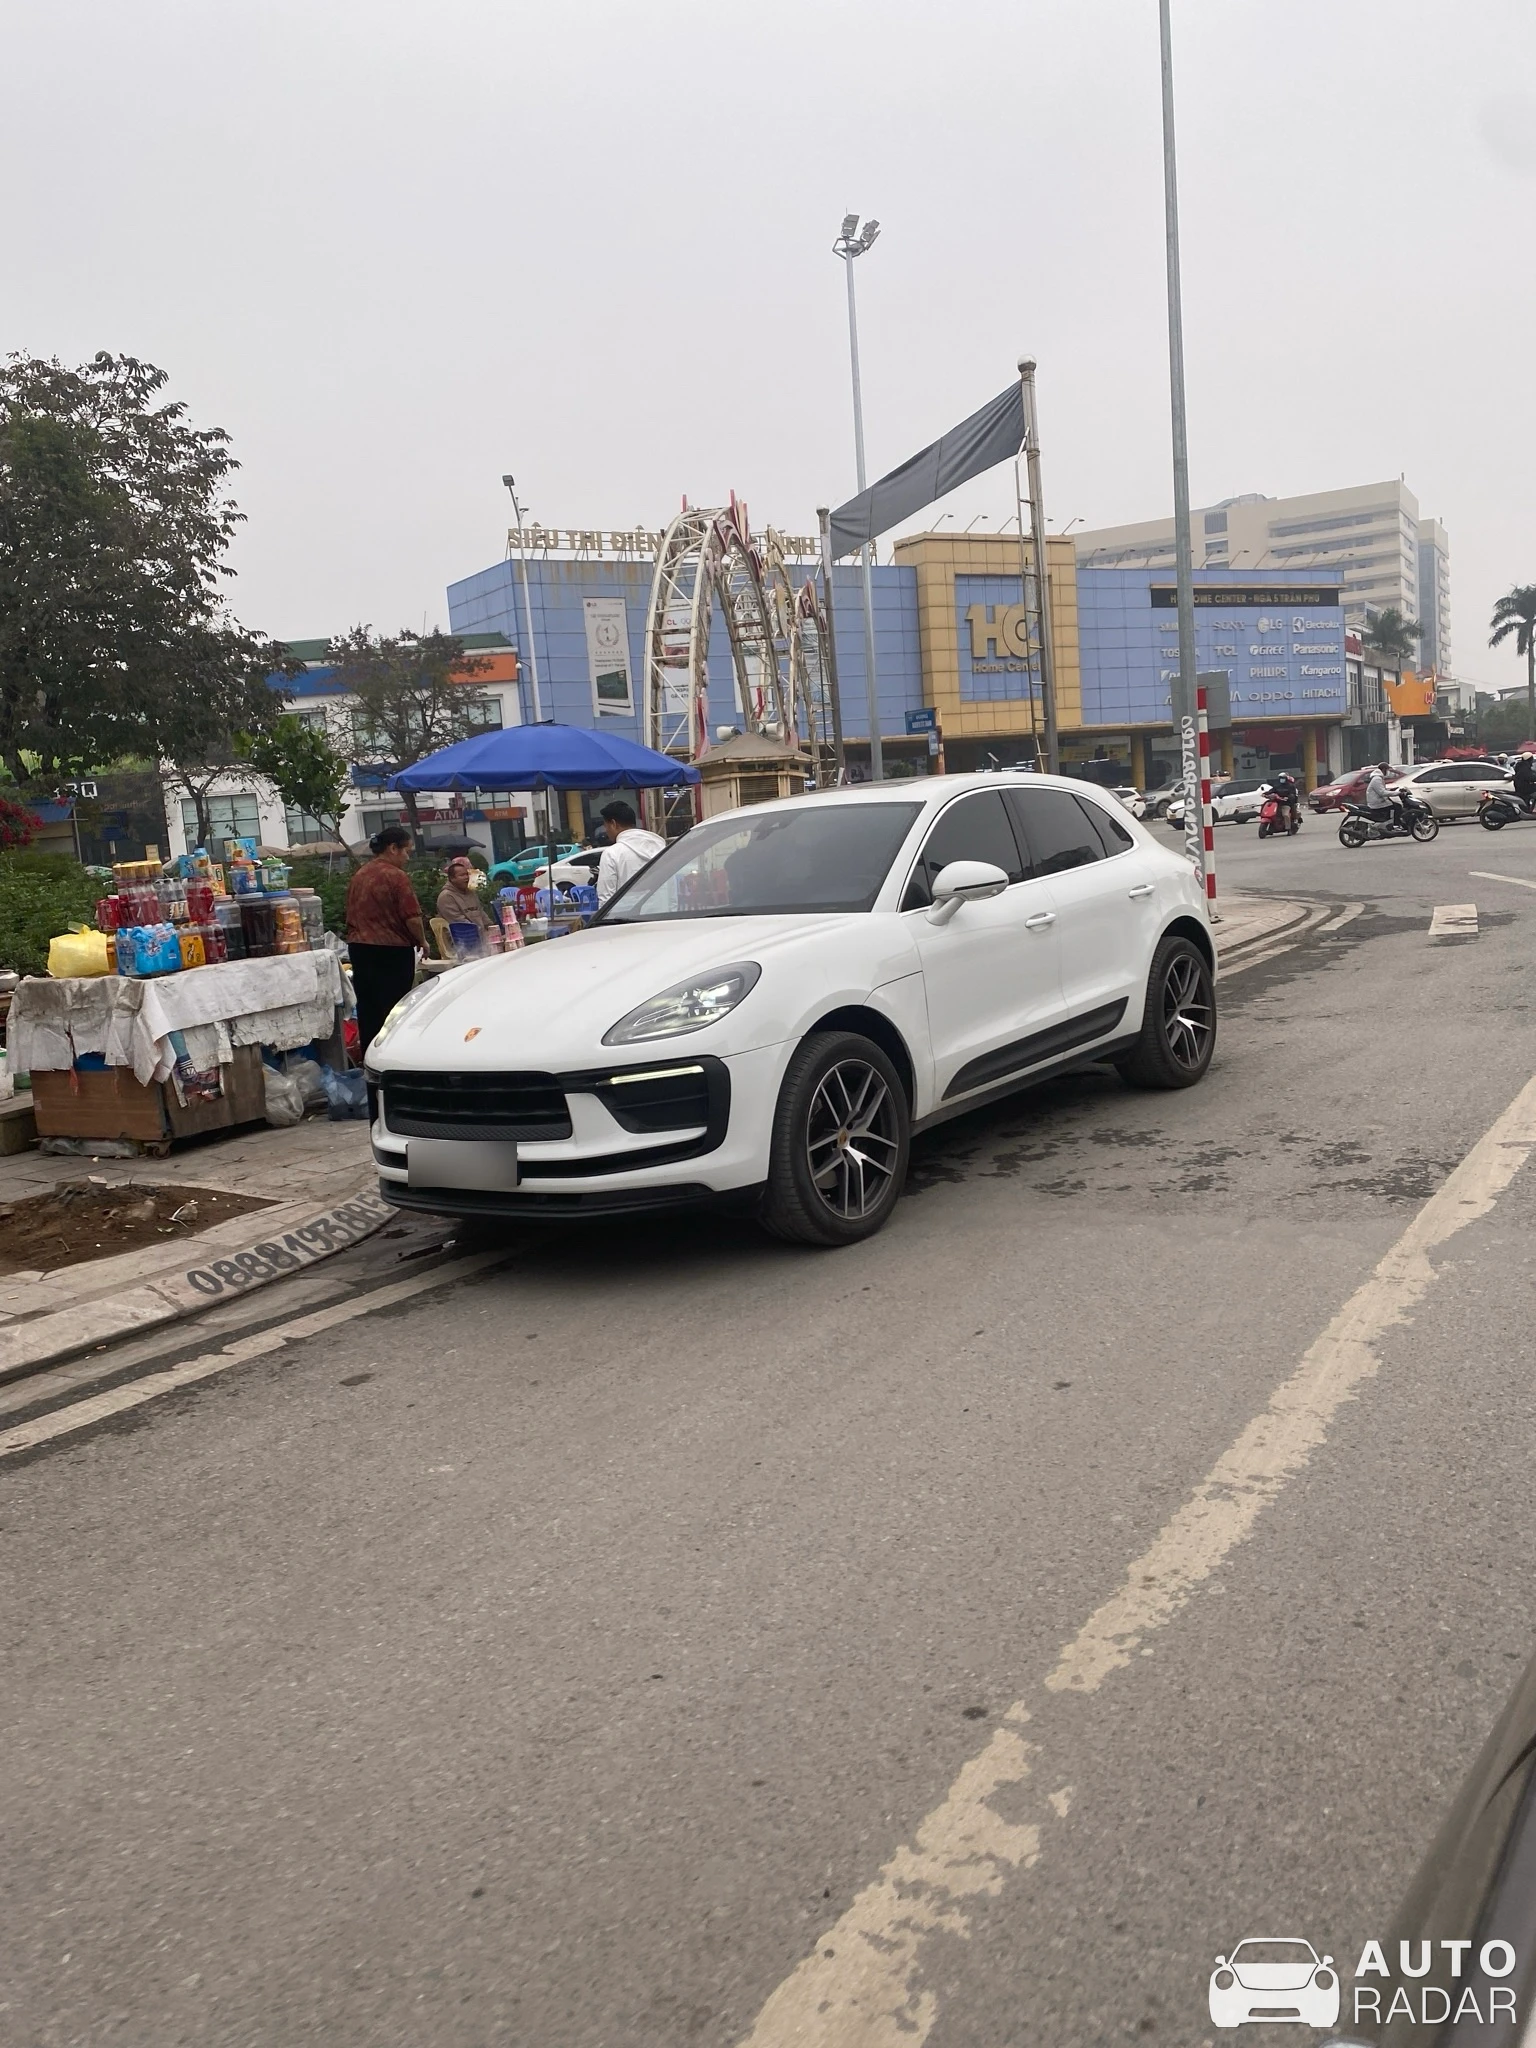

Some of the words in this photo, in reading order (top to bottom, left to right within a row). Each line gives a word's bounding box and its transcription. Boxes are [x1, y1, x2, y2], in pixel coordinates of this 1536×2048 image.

[1213, 620, 1247, 631] SONY
[1269, 617, 1283, 630] LG
[1305, 619, 1341, 630] Electrolux
[1160, 648, 1201, 659] TOSA
[1215, 645, 1239, 657] TCL
[1258, 646, 1285, 656] GREE
[1292, 642, 1340, 655] Panasonic
[973, 662, 1005, 673] Home
[1250, 666, 1288, 679] PHILIPS
[1300, 664, 1342, 677] Kangaroo
[1302, 687, 1342, 699] HITACHI
[434, 810, 460, 820] ATM
